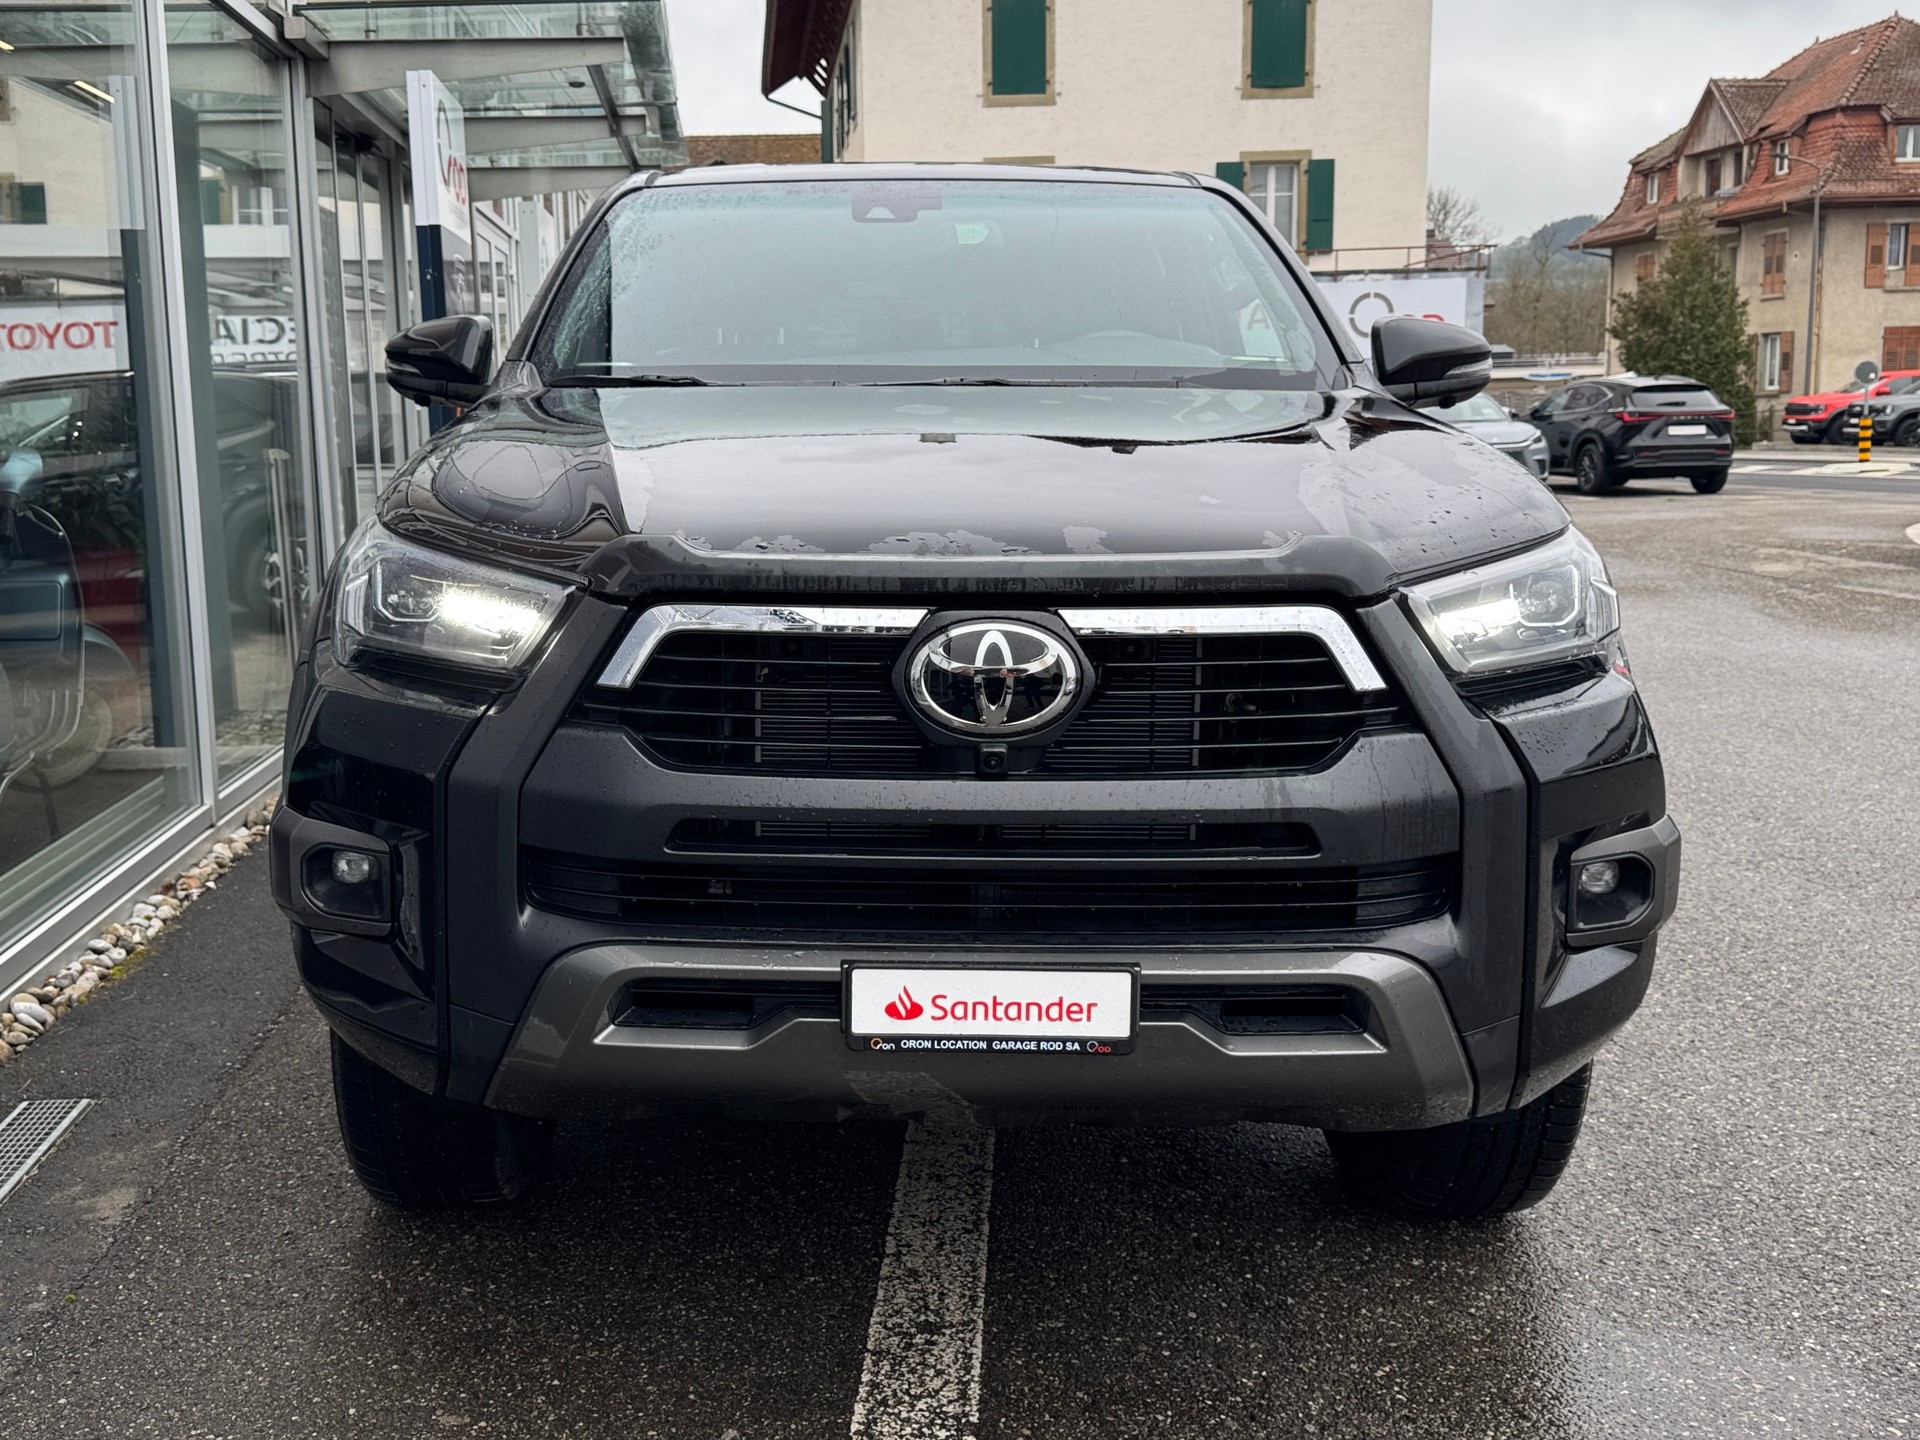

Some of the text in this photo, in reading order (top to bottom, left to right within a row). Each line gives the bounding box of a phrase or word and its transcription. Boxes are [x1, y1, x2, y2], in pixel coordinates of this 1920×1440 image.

[930, 994, 1098, 1022] Santander
[900, 1039, 932, 1050] ORON
[934, 1039, 988, 1050] LOCATION
[992, 1040, 1038, 1051] GARAGE
[1040, 1041, 1064, 1051] ROD
[1065, 1041, 1081, 1051] SA
